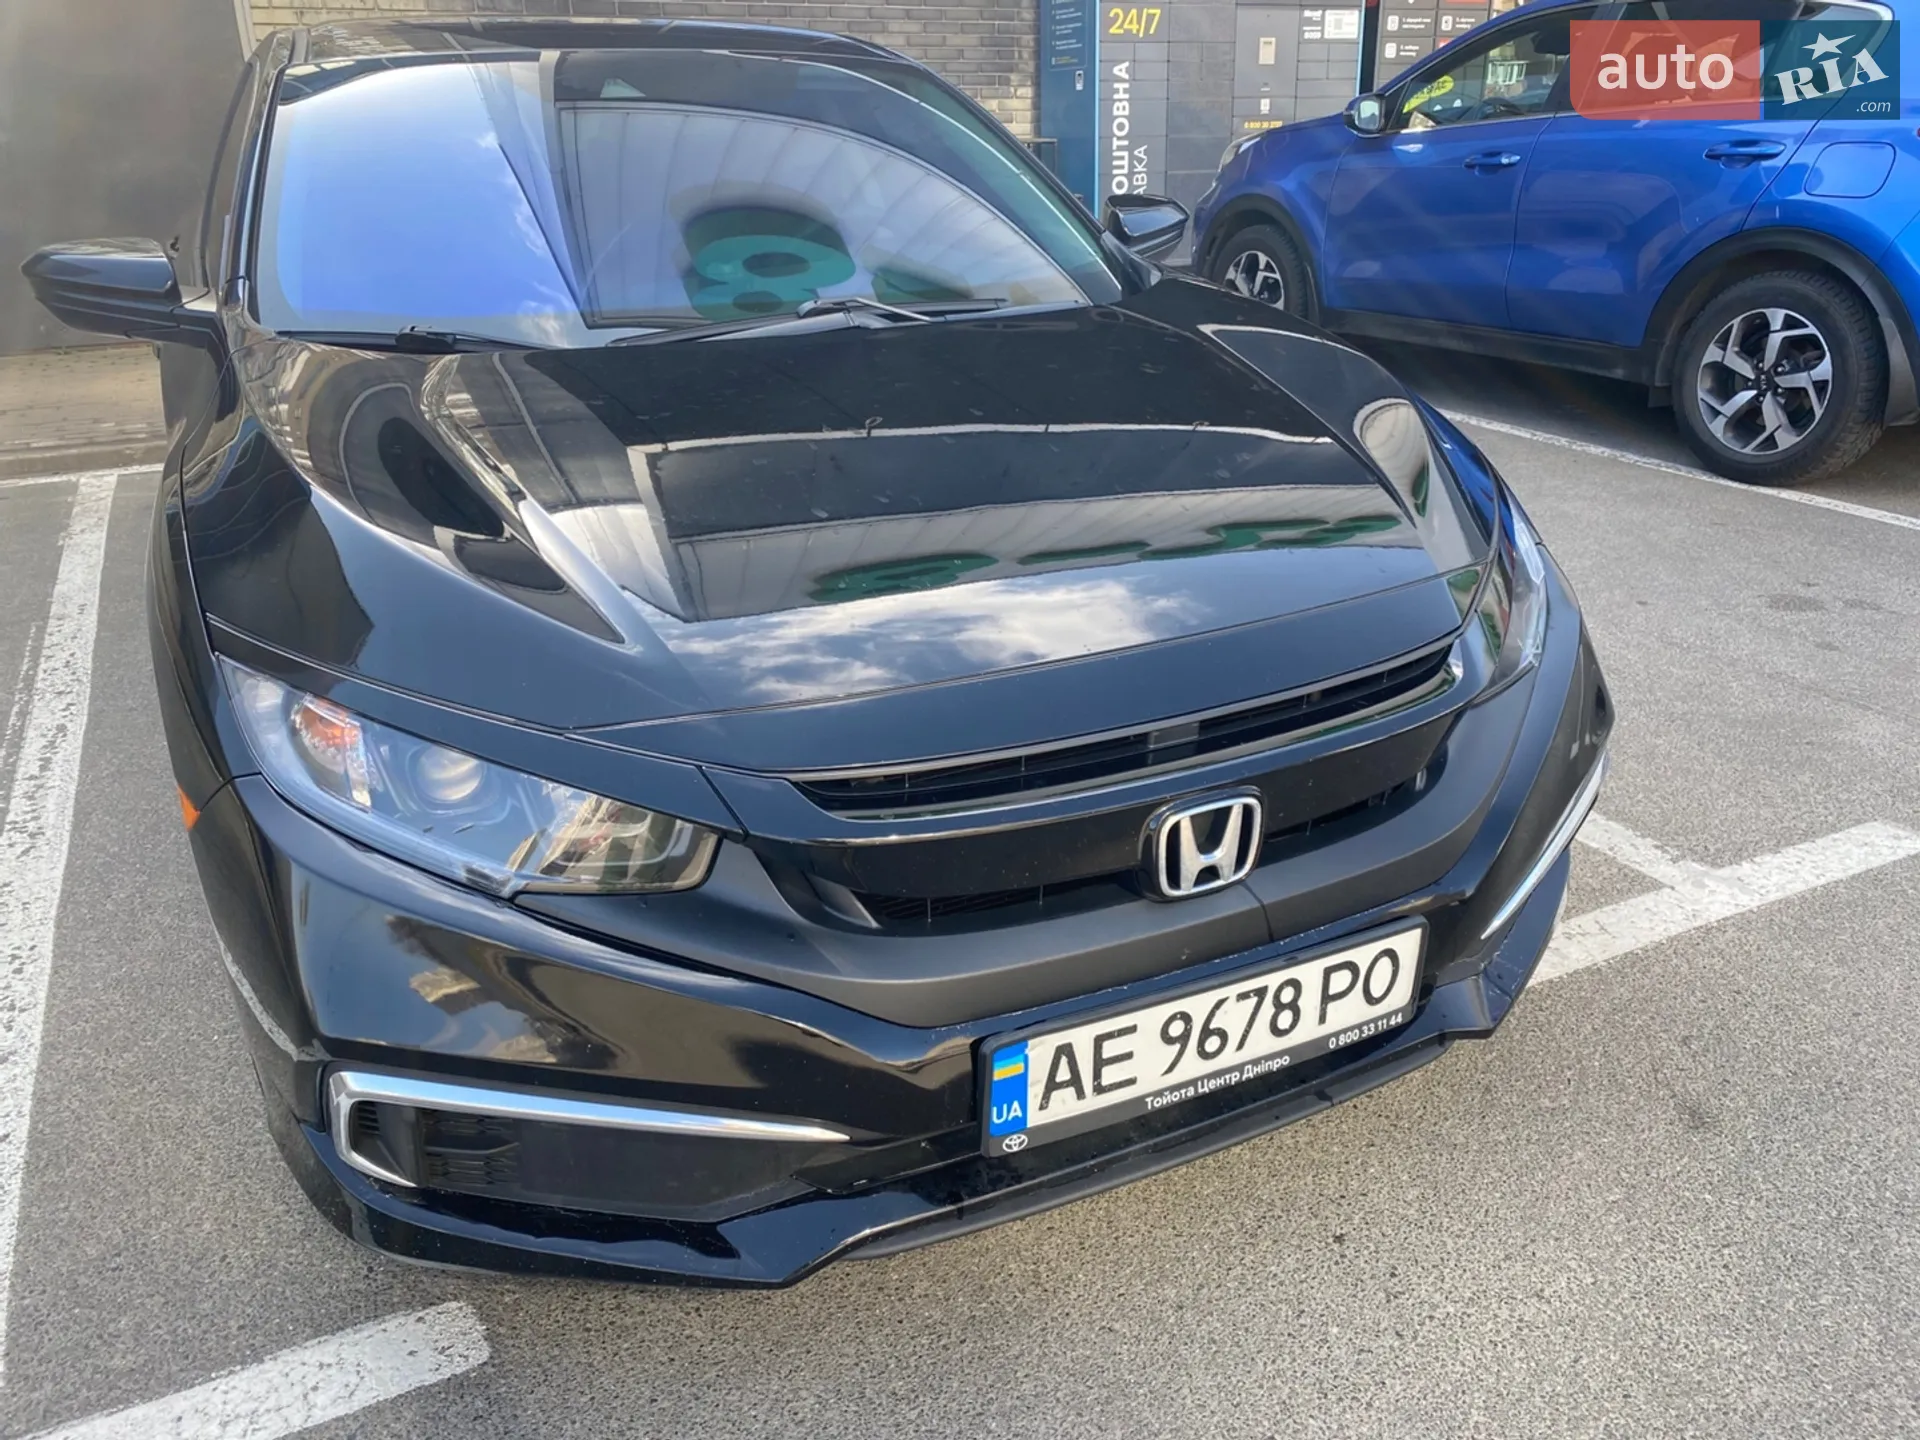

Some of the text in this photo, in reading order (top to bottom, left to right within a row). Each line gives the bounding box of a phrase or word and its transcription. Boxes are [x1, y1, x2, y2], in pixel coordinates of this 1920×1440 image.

[1108, 8, 1161, 38] 24/7
[1112, 61, 1130, 195] ОШТОВНА
[1133, 145, 1148, 195] АВКА
[1038, 948, 1400, 1111] AE 9678 PO
[1328, 1012, 1403, 1049] 0 800 33 11 44
[1145, 1055, 1290, 1110] Тойота Центр Дніпро
[991, 1100, 1022, 1124] UA
